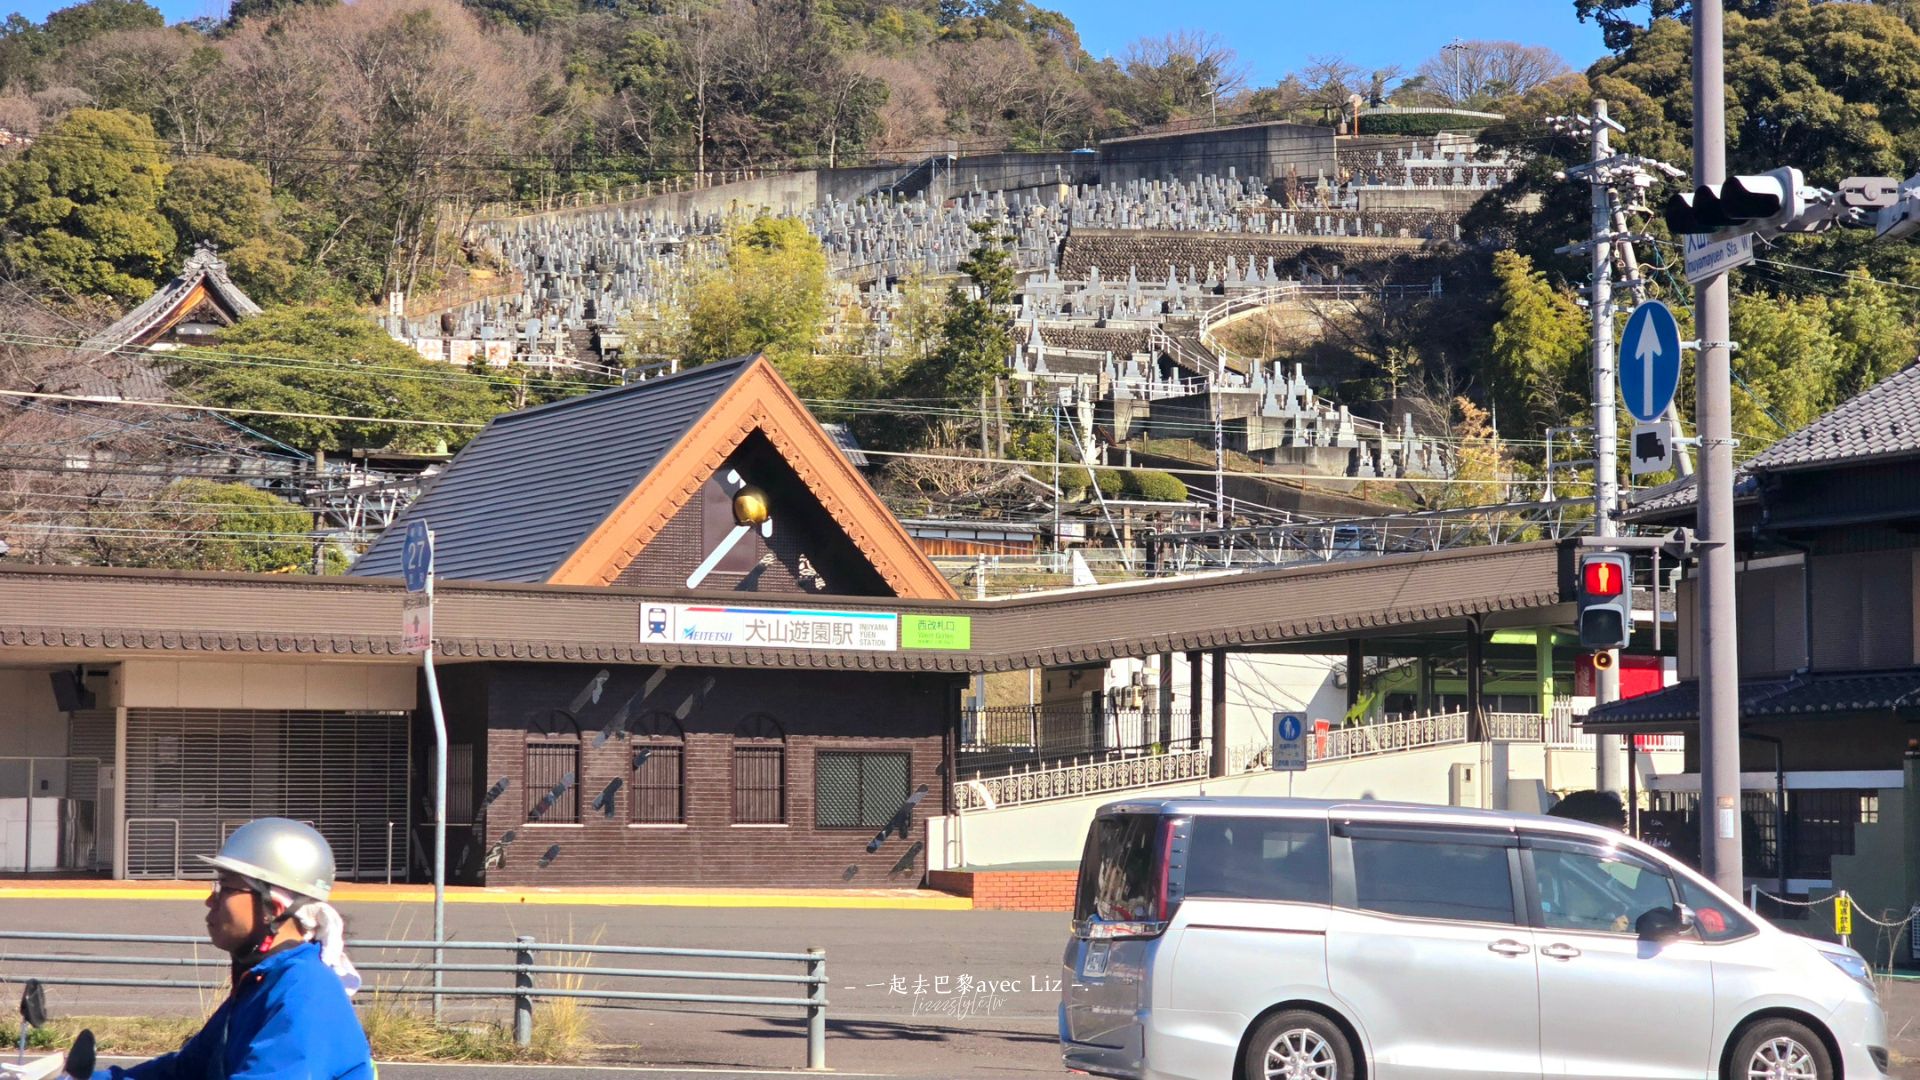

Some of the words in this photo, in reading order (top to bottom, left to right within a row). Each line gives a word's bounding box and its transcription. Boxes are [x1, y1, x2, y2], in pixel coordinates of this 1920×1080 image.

[408, 541, 425, 570] 27
[859, 623, 888, 631] INUYAMA
[917, 619, 955, 631] 西改札口
[683, 625, 733, 642] MEITETSU
[745, 618, 853, 645] 犬山遊園駅
[859, 631, 876, 639] YUEN
[859, 639, 886, 647] STATION
